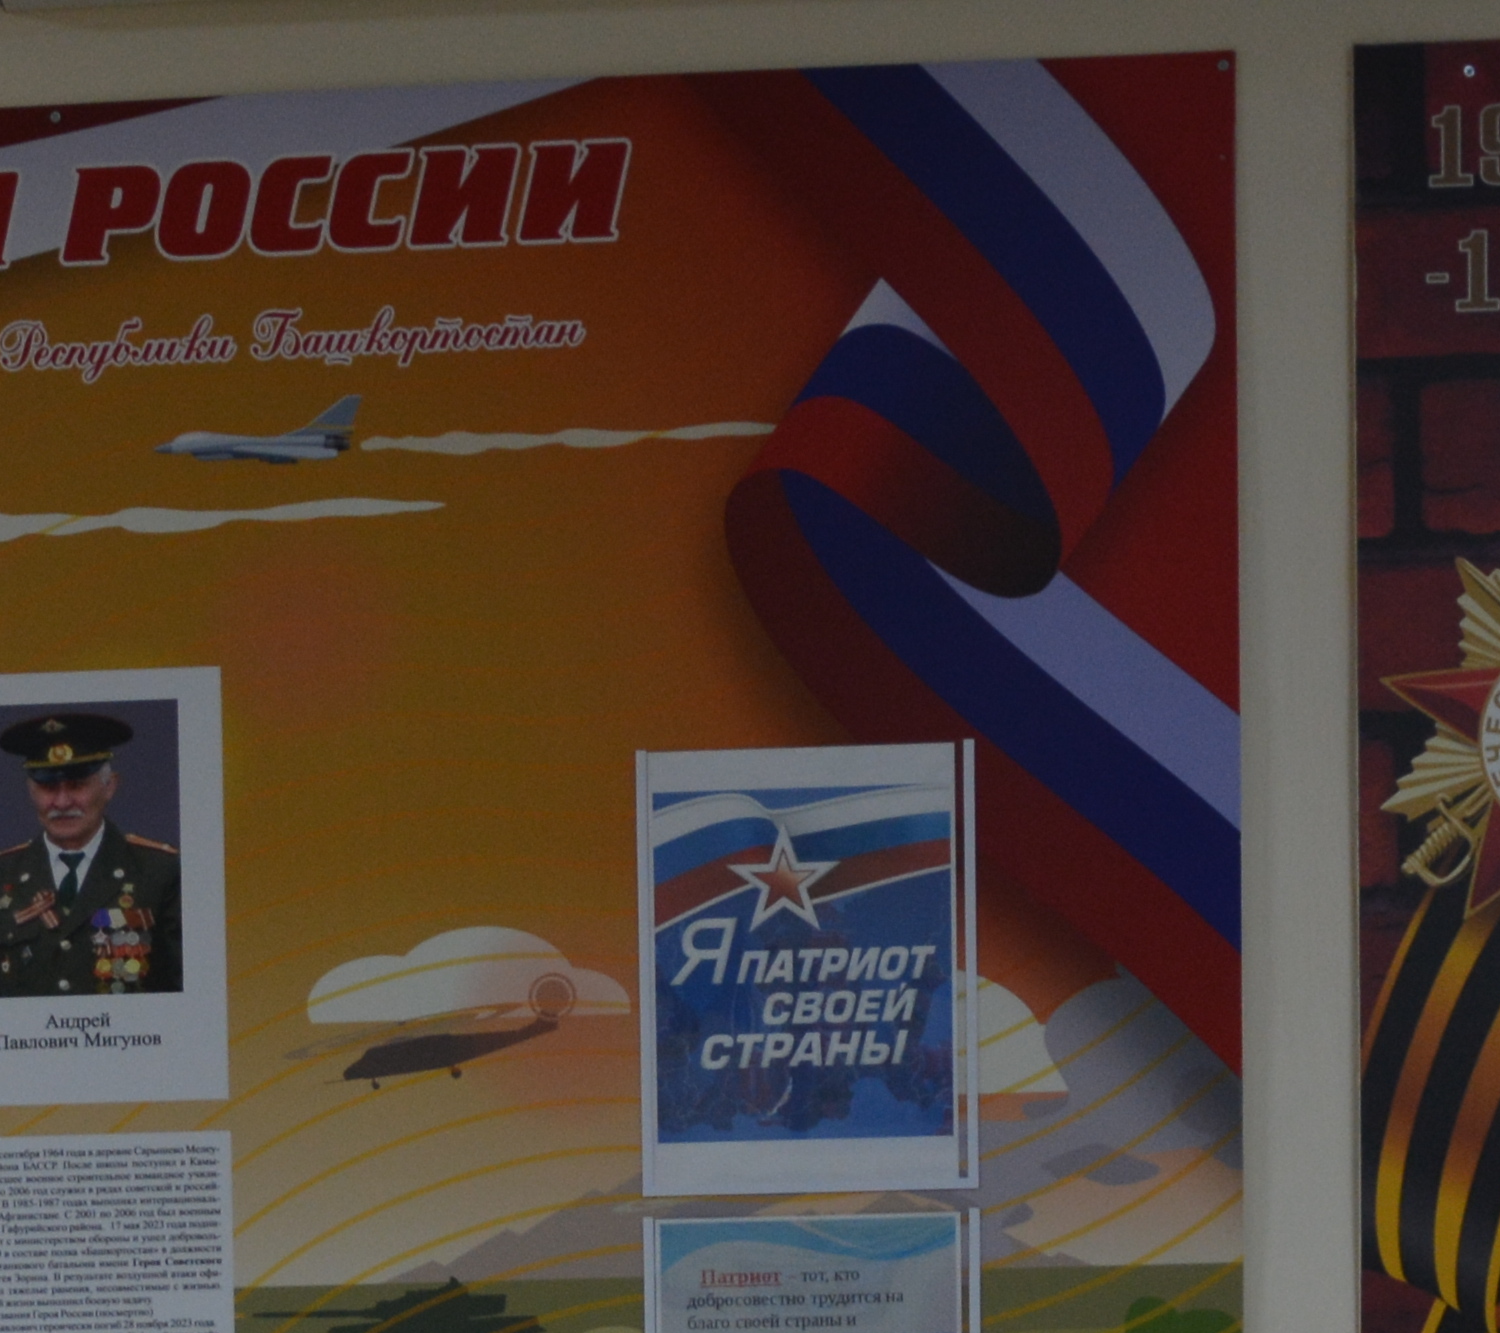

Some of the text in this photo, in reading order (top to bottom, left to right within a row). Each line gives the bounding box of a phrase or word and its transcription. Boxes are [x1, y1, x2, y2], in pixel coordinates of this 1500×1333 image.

[58, 138, 631, 267] РОССИИ
[251, 304, 585, 366] Башкортостан
[670, 917, 936, 986] Я ПАТРИОТ
[762, 982, 917, 1025] СВОЕЙ
[45, 1013, 110, 1031] Андрей
[84, 1033, 162, 1049] Мигунов
[700, 1030, 909, 1070] СТРАНЫ
[701, 1269, 860, 1287] Патриот тот, кто
[687, 1291, 904, 1309] добросовестно трудится на
[687, 1314, 857, 1330] благо своей страны и
